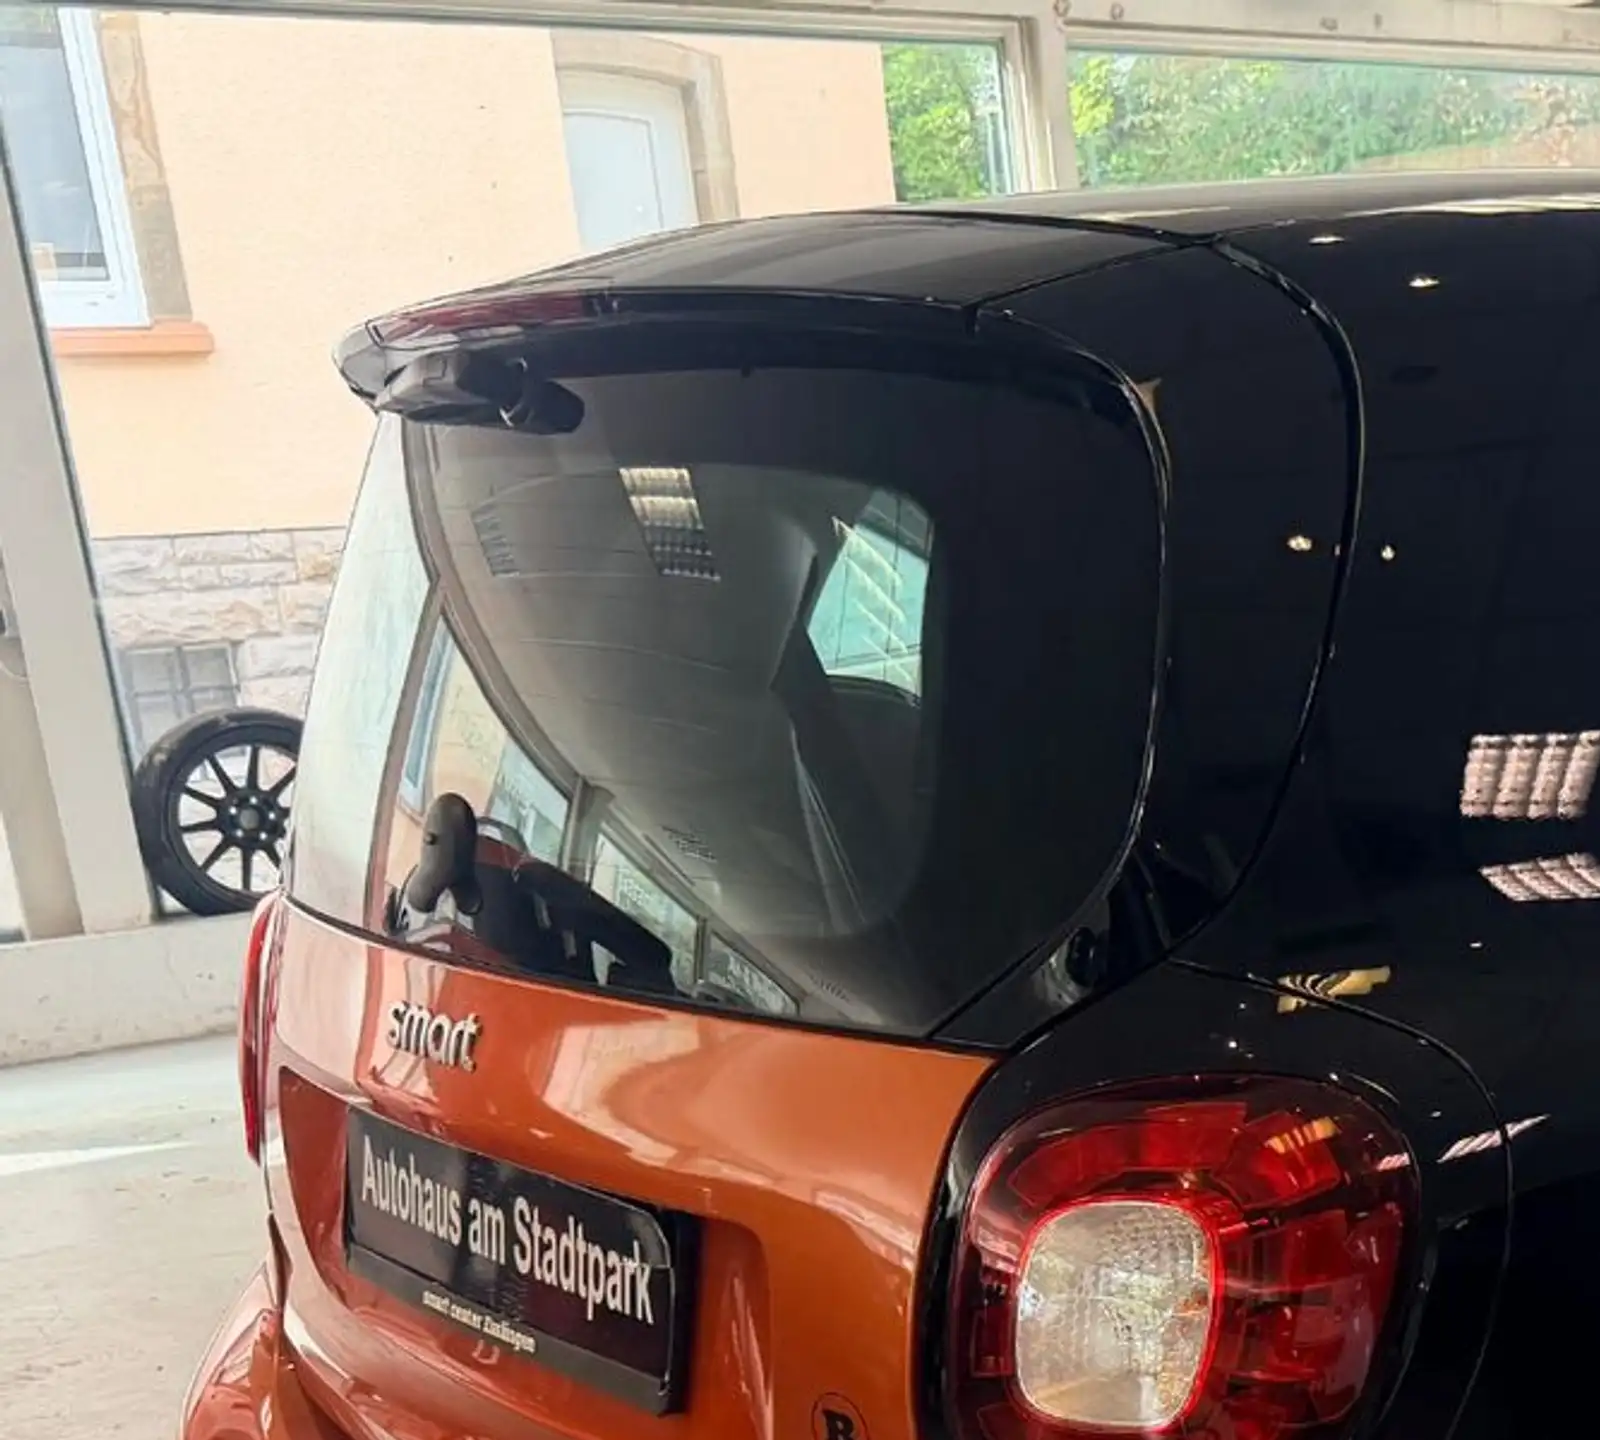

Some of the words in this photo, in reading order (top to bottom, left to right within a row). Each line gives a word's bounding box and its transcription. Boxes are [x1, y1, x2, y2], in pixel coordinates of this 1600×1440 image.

[386, 1000, 482, 1072] smart
[362, 1134, 462, 1247] Autohaus
[467, 1197, 506, 1266] am
[512, 1196, 655, 1325] Stadtpark
